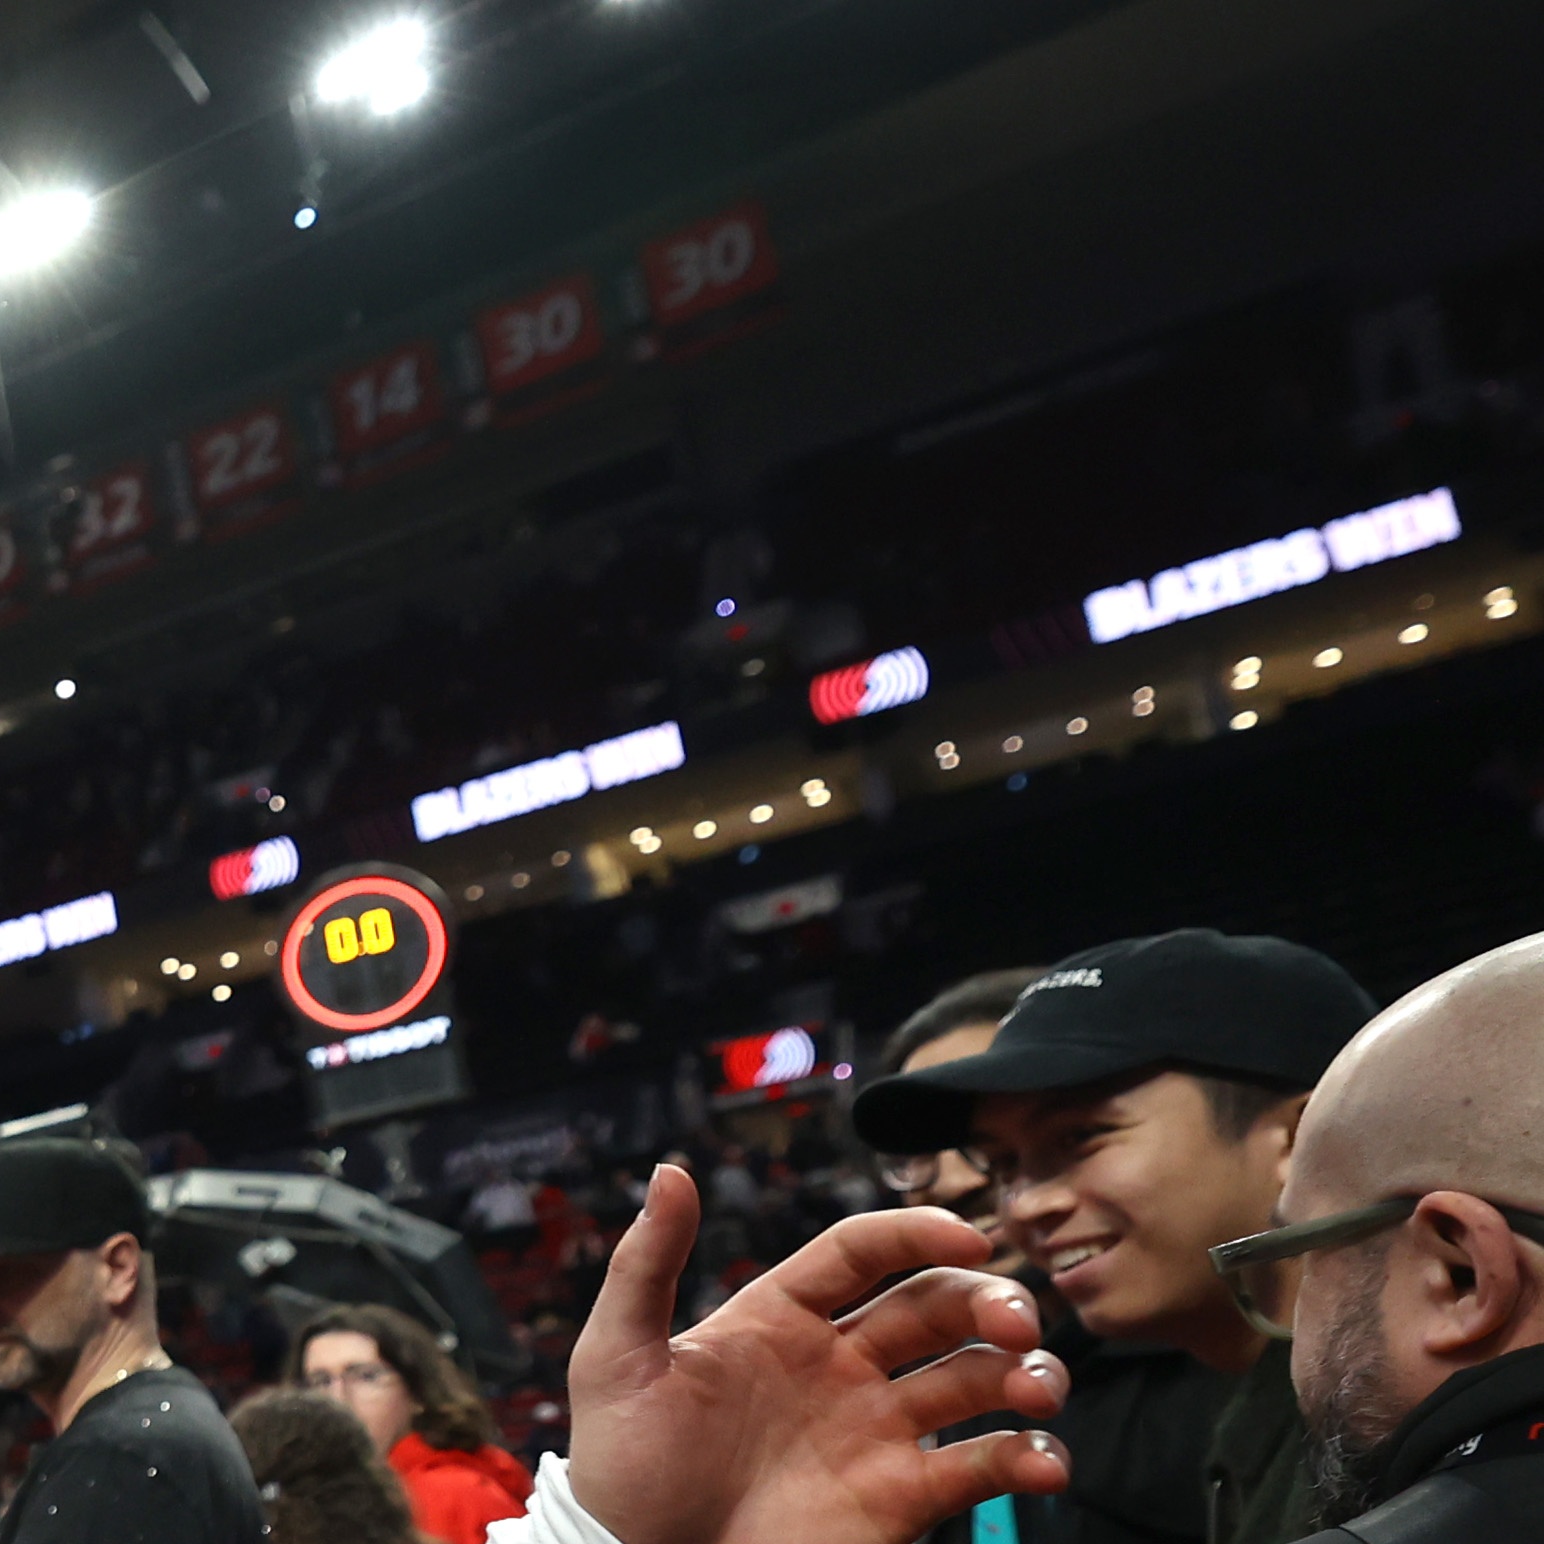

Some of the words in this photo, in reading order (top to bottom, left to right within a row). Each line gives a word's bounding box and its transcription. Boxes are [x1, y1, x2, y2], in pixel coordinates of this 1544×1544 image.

[662, 221, 755, 309] 30
[494, 293, 583, 377] 30
[346, 356, 421, 432] 14
[202, 413, 282, 497] 22
[1083, 526, 1331, 645] BLAZERS
[1322, 486, 1462, 572] WIN
[411, 750, 590, 843] BLAZERS
[584, 720, 686, 791] WIN
